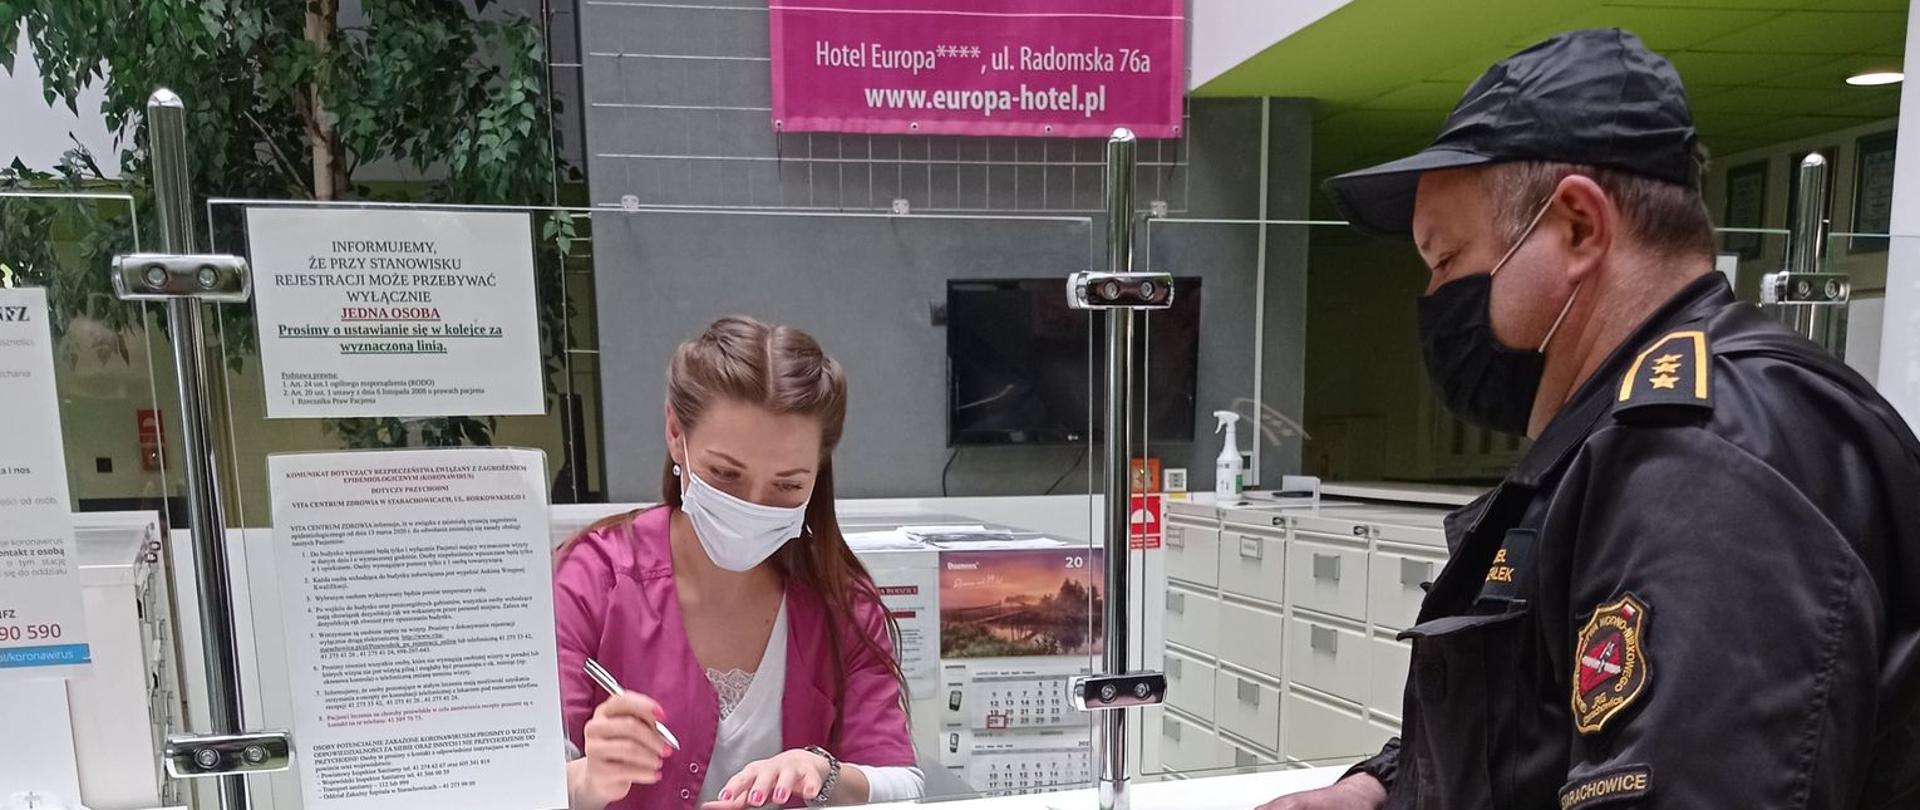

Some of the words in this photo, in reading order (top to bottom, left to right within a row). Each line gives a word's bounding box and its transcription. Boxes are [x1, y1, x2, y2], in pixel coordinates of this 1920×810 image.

[816, 41, 866, 68] Hotel
[991, 46, 1014, 71] ul.
[1020, 46, 1114, 72] Radomska
[1119, 48, 1151, 73] 76a
[865, 83, 1106, 117] www.europa-hotel.pl
[332, 240, 437, 254] INFORMUJEMY,
[308, 256, 327, 270] ŻE
[330, 257, 366, 270] PRZY
[370, 257, 462, 270] STANOWISKU
[275, 274, 365, 286] REJESTRACJI
[369, 272, 409, 286] MOŻE
[412, 272, 497, 287] PRZEBYWAĆ
[346, 291, 432, 304] WYŁĄCZNIE
[341, 307, 388, 320] JEDNA
[391, 307, 441, 320] OSOBA
[278, 324, 330, 337] Prosimy
[333, 327, 341, 335] o
[344, 324, 409, 336] ustawianie
[412, 324, 428, 337] się
[431, 327, 441, 335] w
[444, 323, 486, 337] kolejce
[488, 326, 502, 335] za
[340, 341, 414, 354] wyznaczoną
[417, 340, 447, 353] linią.
[408, 379, 435, 387] (RODO)
[37, 547, 65, 558] osobą
[1065, 556, 1084, 569] 20
[27, 623, 62, 640] 590
